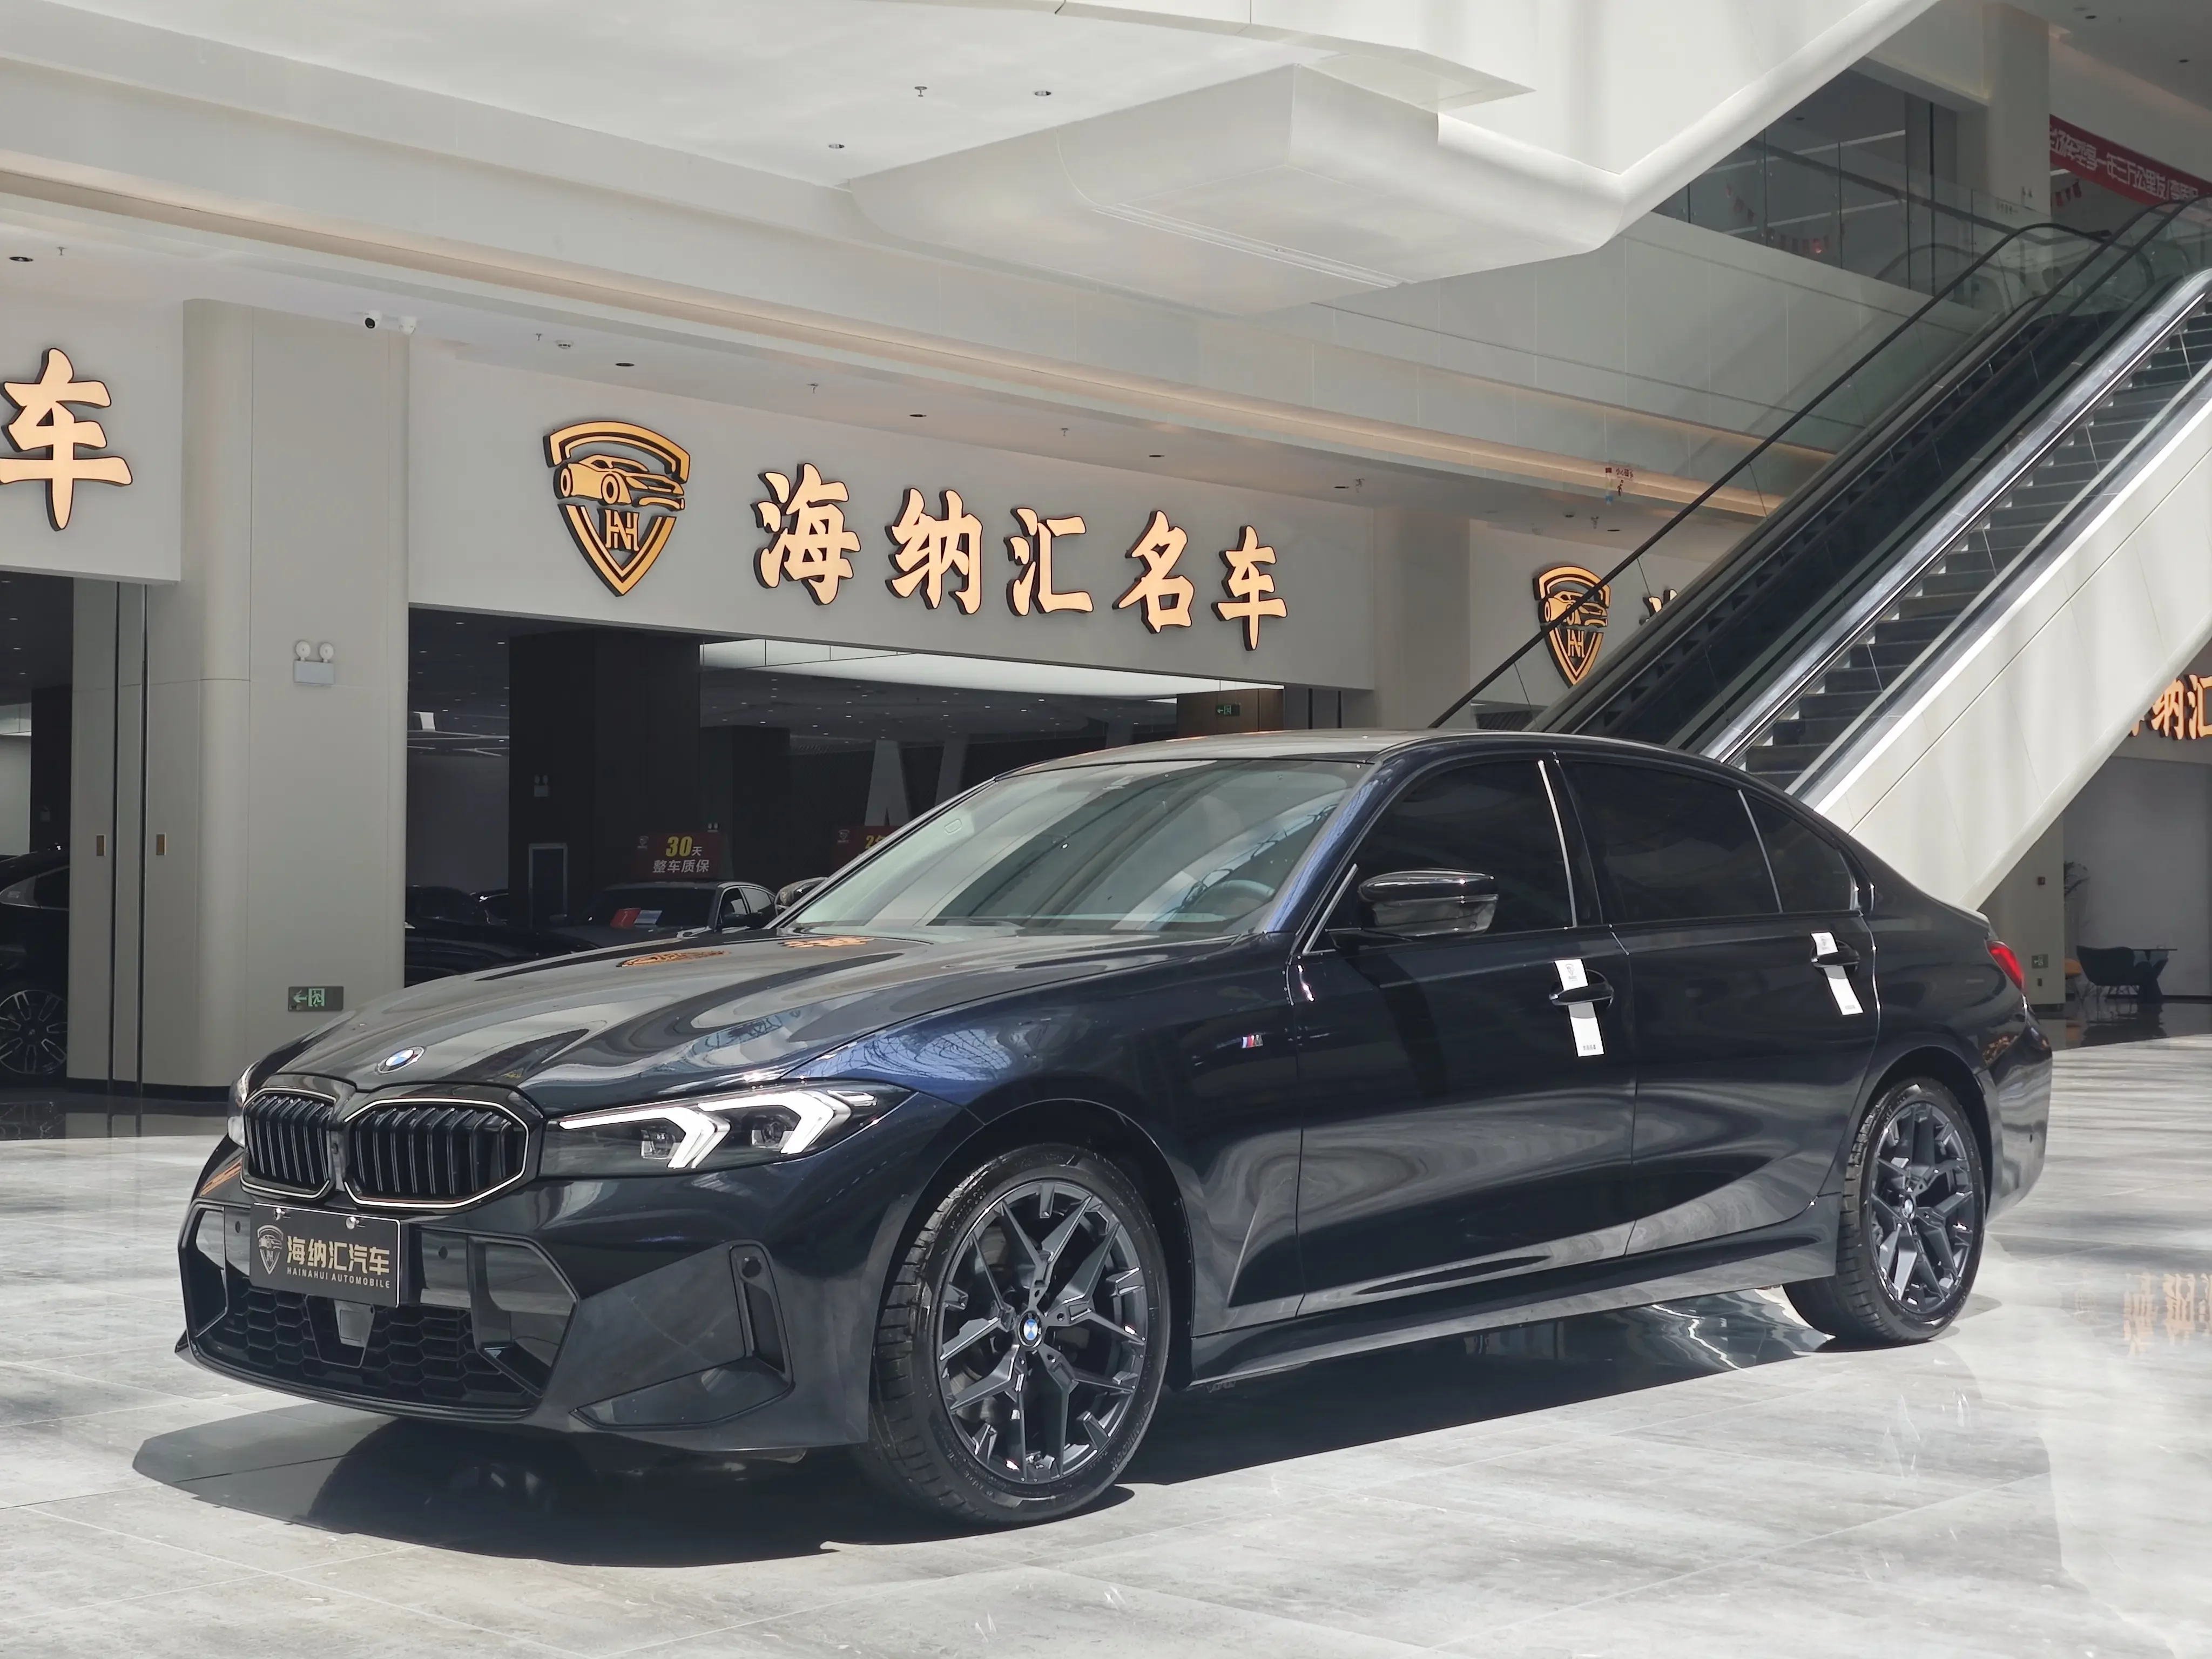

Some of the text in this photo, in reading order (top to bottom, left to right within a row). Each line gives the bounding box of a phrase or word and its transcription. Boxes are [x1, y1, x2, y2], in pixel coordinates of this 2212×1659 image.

[0, 348, 133, 531] 车
[753, 463, 1287, 650] 海纳汇名车
[2132, 675, 2212, 740] 纳汇
[652, 859, 710, 873] 整车质保
[287, 1235, 390, 1276] 海纳汇汽车
[287, 1266, 390, 1289] HAINAHUI AUTOMOBILE
